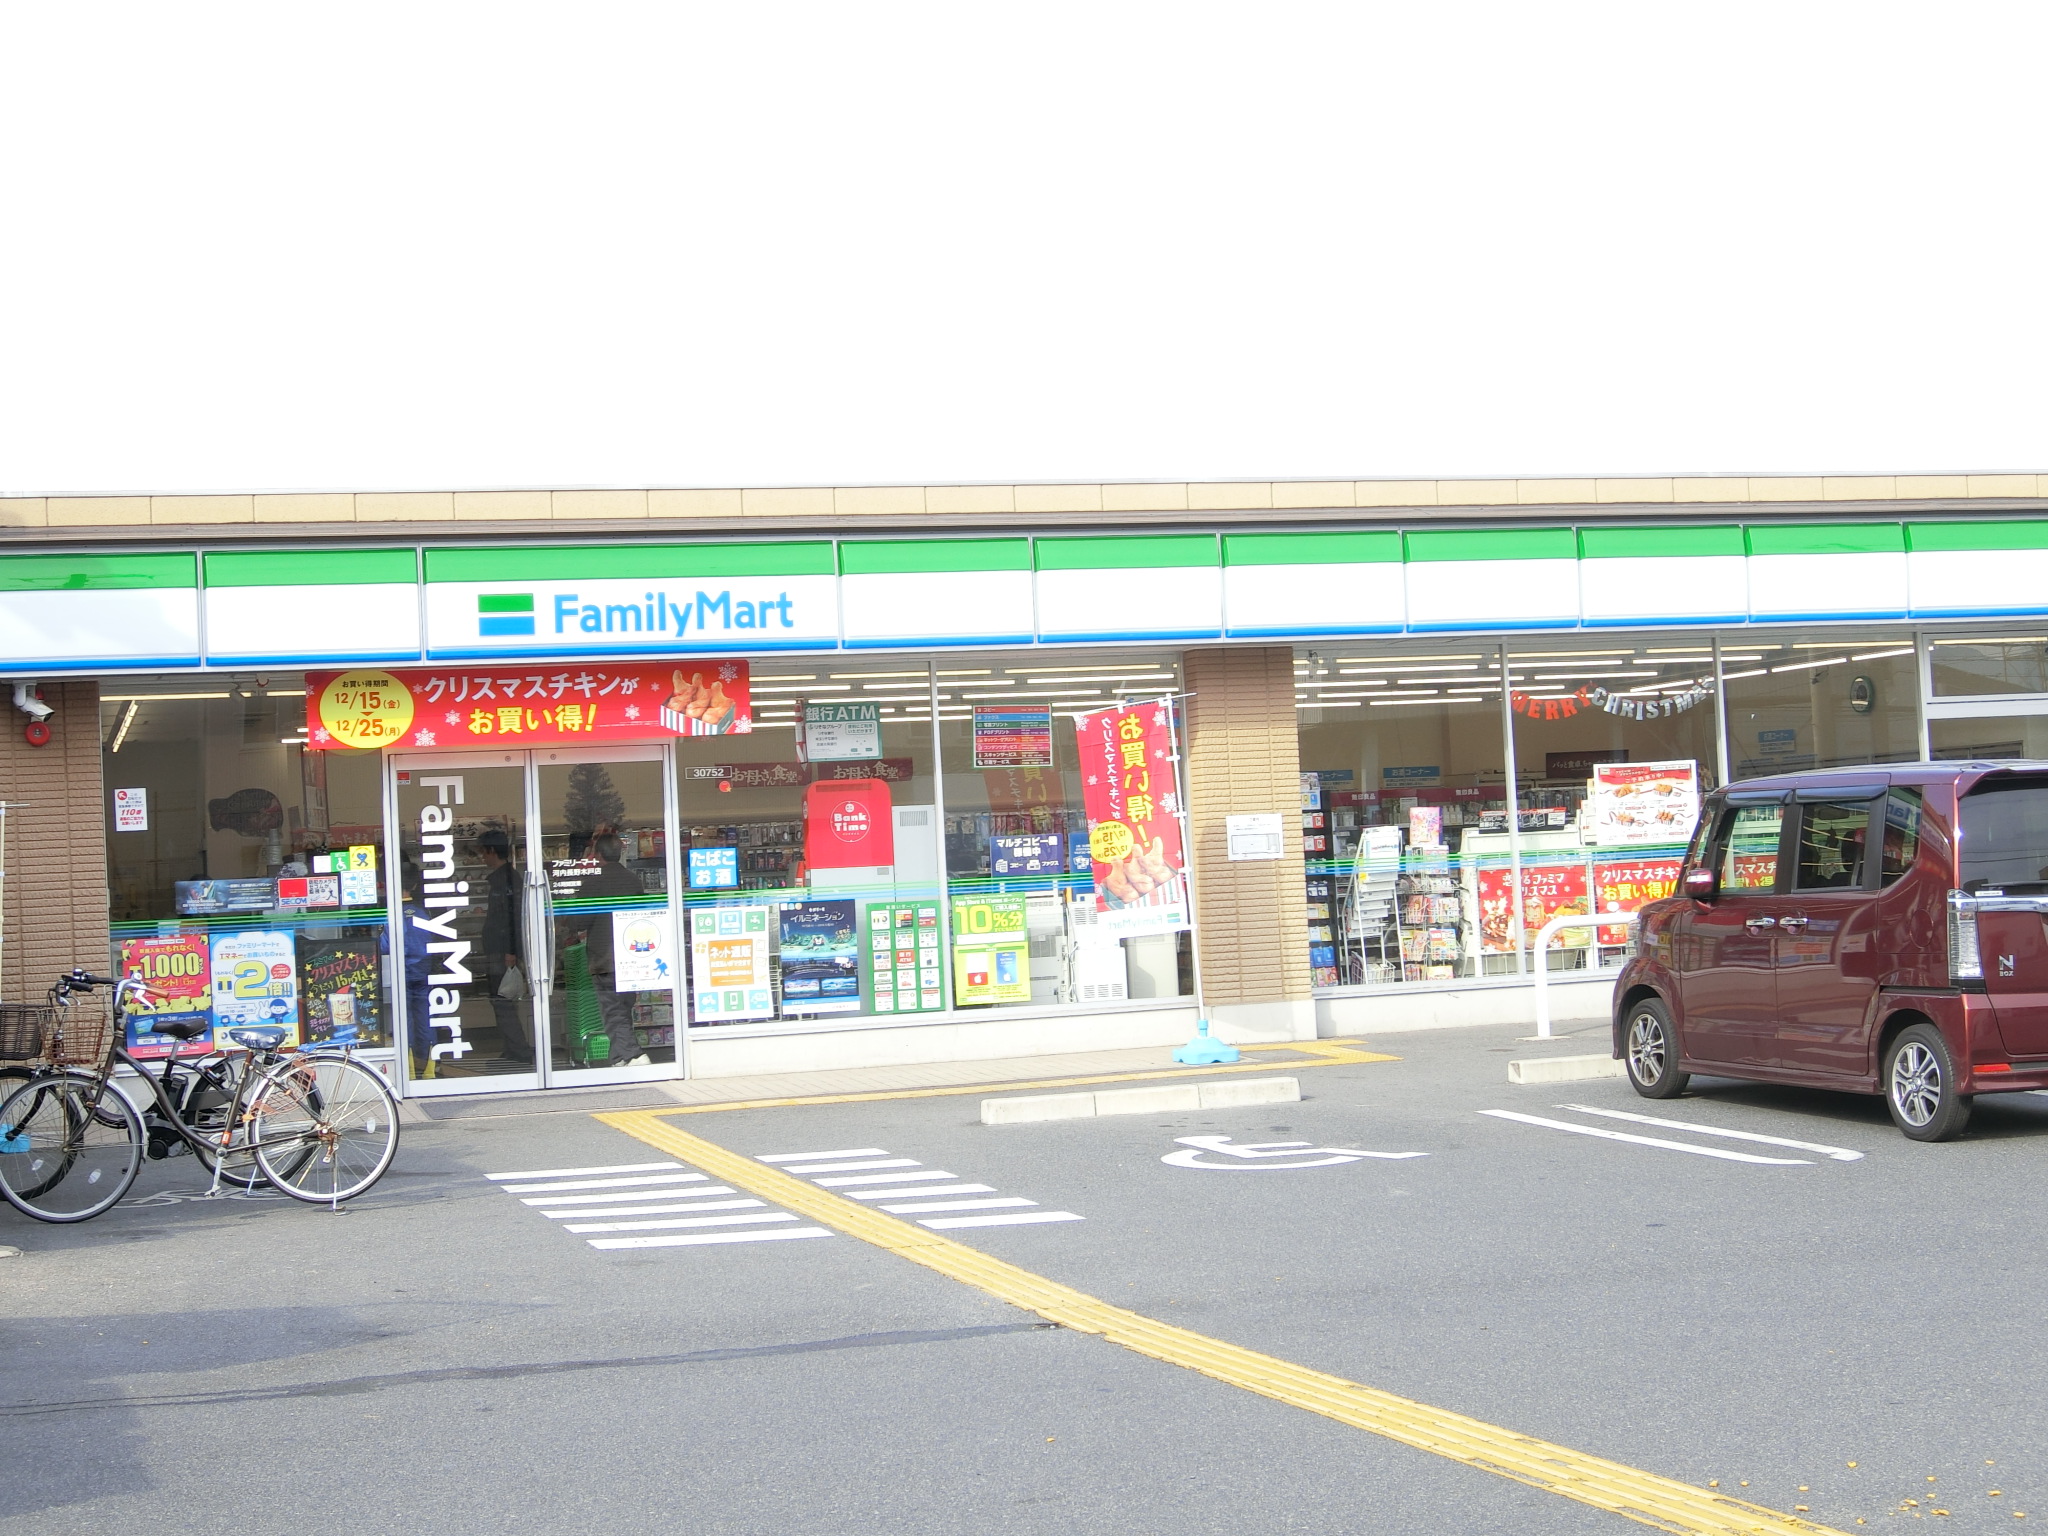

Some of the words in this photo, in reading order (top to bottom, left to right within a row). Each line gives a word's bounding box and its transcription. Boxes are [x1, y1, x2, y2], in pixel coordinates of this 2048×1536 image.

[554, 591, 794, 637] FamilyMart
[342, 680, 389, 688] お買い得期間
[424, 671, 640, 704] クリスマスチキンが
[1511, 683, 1593, 720] MERRY
[468, 703, 598, 735] お買い得!
[693, 768, 724, 777] 30752
[731, 765, 798, 786] お母さん食堂
[1351, 793, 1376, 801] 無印良品
[1455, 788, 1480, 796] 無印良品
[834, 812, 867, 822] Bank
[834, 822, 868, 832] Time
[551, 858, 600, 867] ファミリーマート
[690, 850, 736, 867] たばこ
[552, 867, 602, 877] 河内長野木戸店
[695, 868, 732, 885] お酒
[1502, 872, 1565, 887] 恋るファミマ
[1521, 884, 1558, 896] リスマス
[413, 776, 473, 1061] FamilyMart
[790, 912, 845, 923] イルミネーション
[140, 952, 200, 980] 1,000
[311, 981, 334, 994] 今だけ
